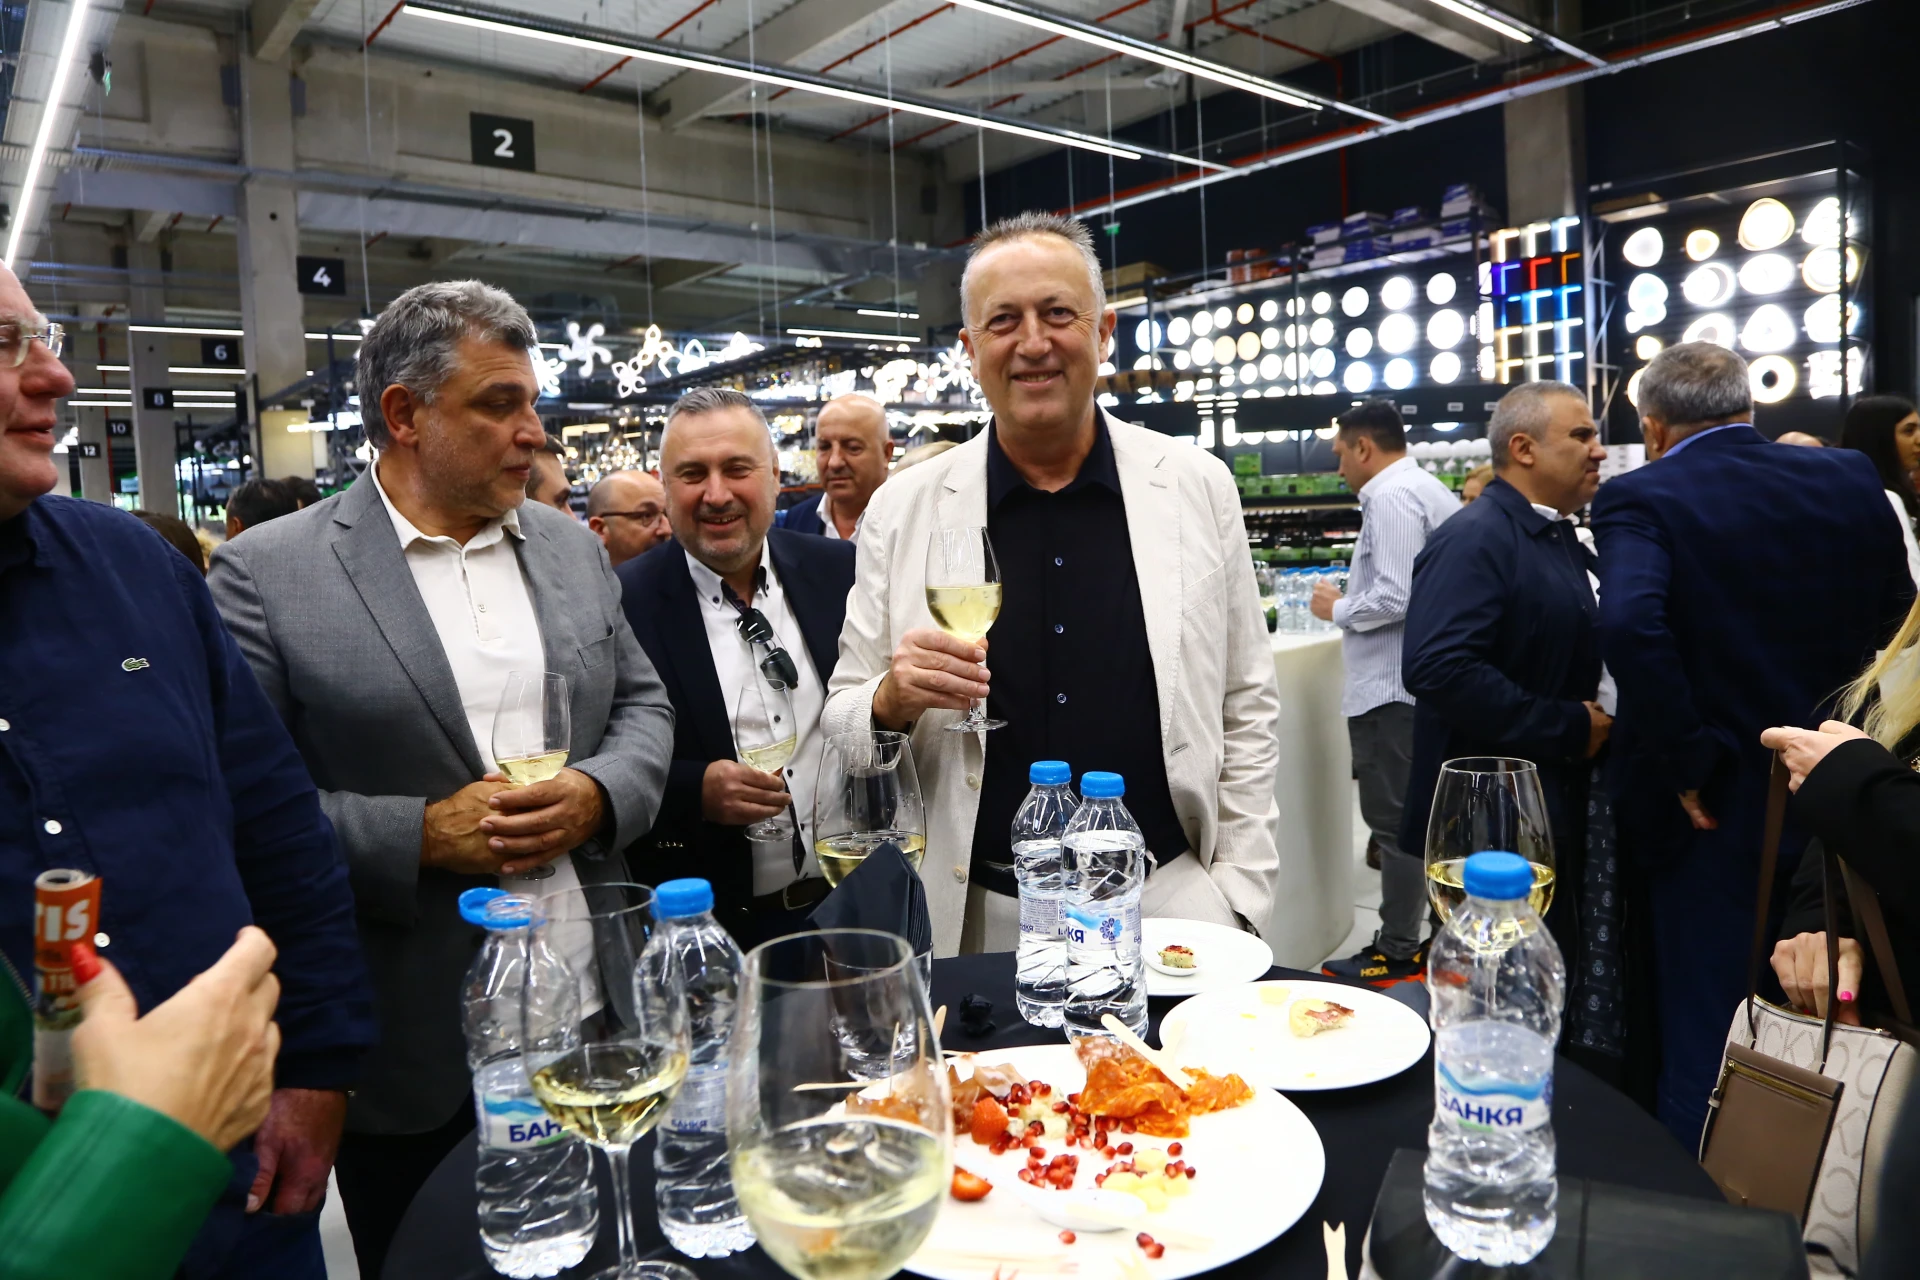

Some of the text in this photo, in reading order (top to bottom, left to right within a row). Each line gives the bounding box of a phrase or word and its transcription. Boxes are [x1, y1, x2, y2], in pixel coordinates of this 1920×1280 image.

[492, 128, 515, 159] 2
[312, 266, 332, 288] 4
[213, 344, 228, 361] 6
[153, 392, 165, 406] 8
[111, 422, 126, 434] 10
[83, 445, 97, 457] 12
[1439, 1086, 1523, 1127] БАНКЯ
[508, 1118, 562, 1143] БАН
